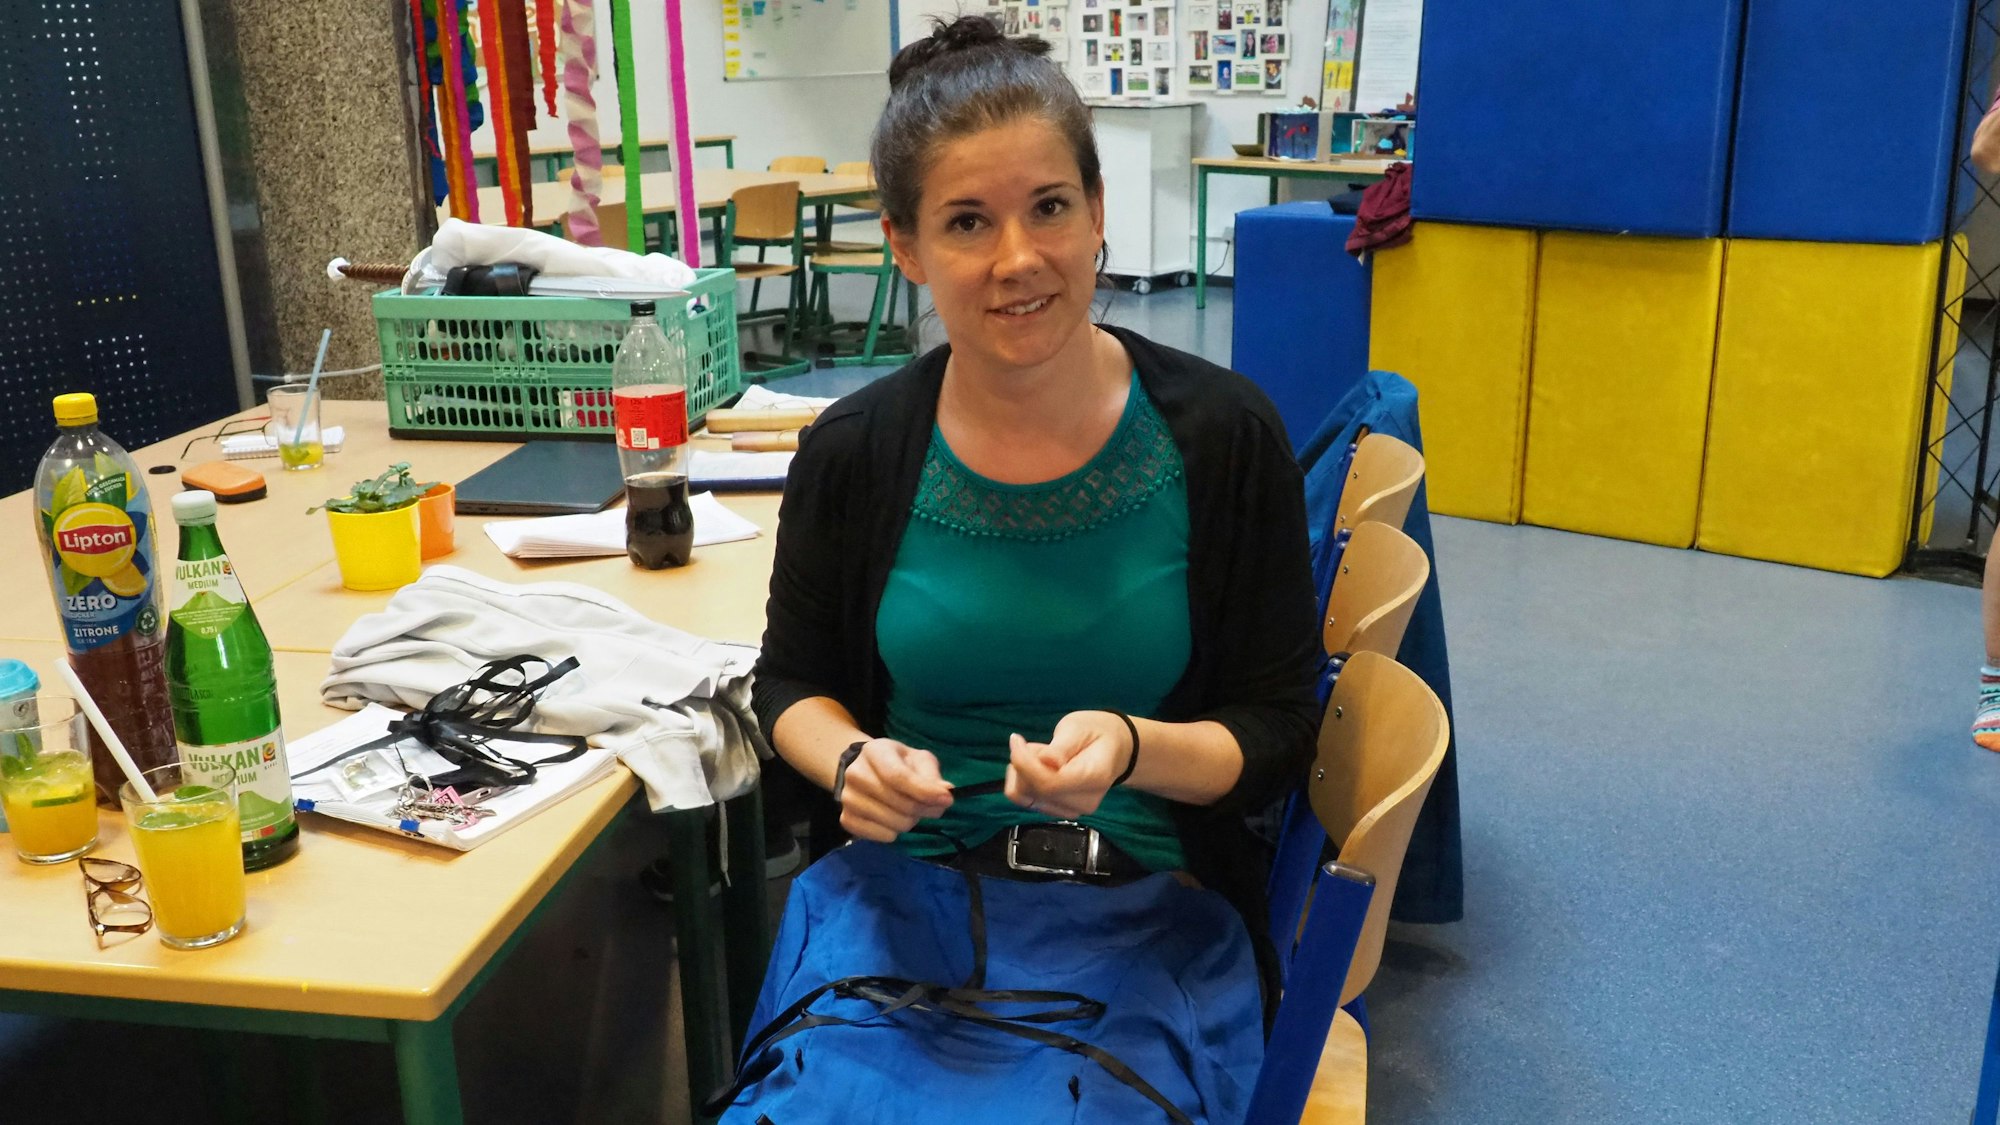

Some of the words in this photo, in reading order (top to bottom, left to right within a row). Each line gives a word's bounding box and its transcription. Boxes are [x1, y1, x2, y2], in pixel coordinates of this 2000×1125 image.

[63, 529, 127, 551] Lipton
[187, 579, 219, 590] MEDIUM
[66, 593, 117, 611] ZERO
[73, 625, 120, 638] ZITRONE
[188, 746, 261, 773] VULKAN
